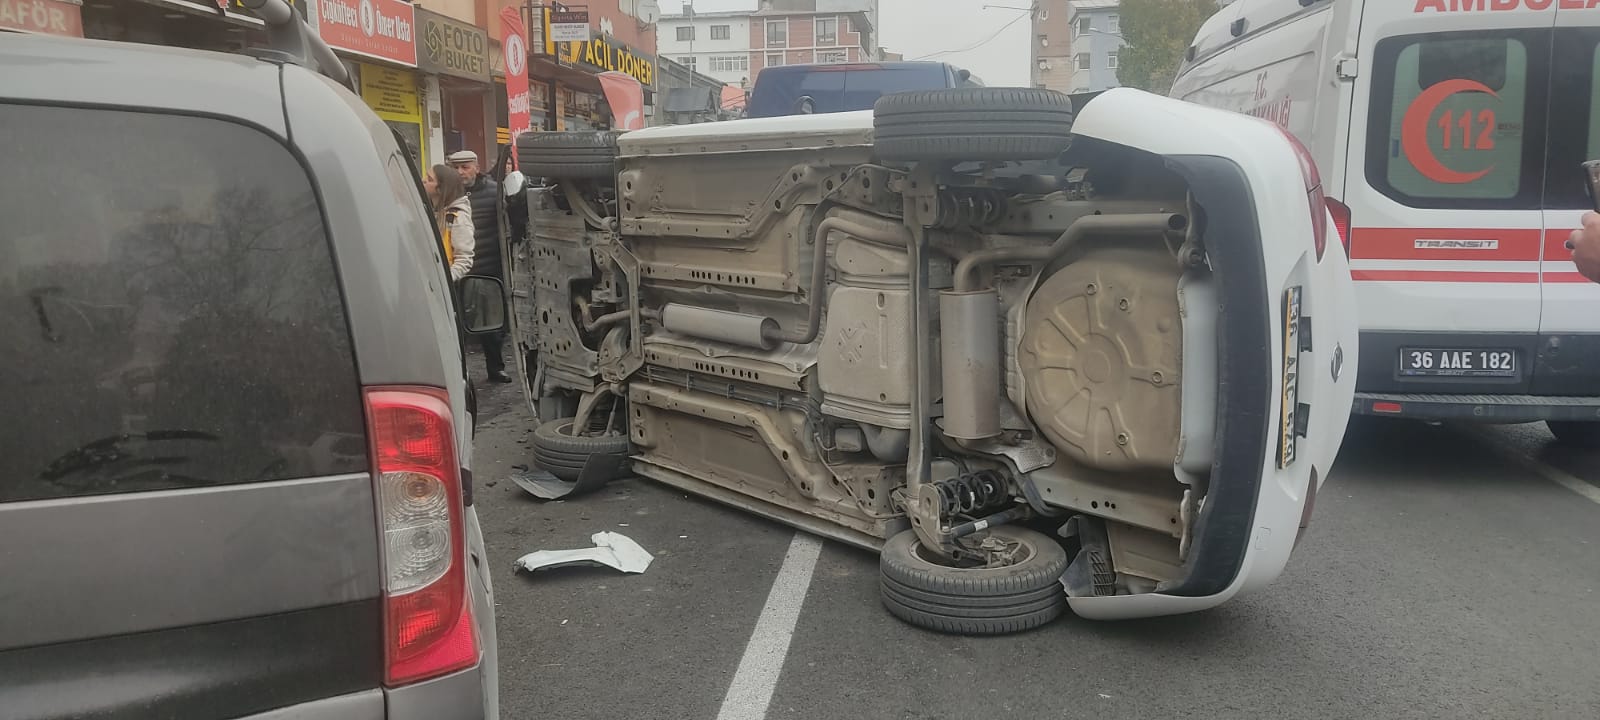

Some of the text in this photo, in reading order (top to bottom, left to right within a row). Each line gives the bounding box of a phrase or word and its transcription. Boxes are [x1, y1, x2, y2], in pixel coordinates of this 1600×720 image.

[376, 4, 395, 38] Ömer
[395, 15, 411, 42] Usta
[443, 24, 483, 54] FOTO
[445, 52, 484, 74] BUKET
[617, 45, 652, 86] DÖNER
[1437, 108, 1495, 151] 112
[1415, 240, 1496, 248] TRANSIT
[1411, 351, 1511, 369] 36 AAE 182
